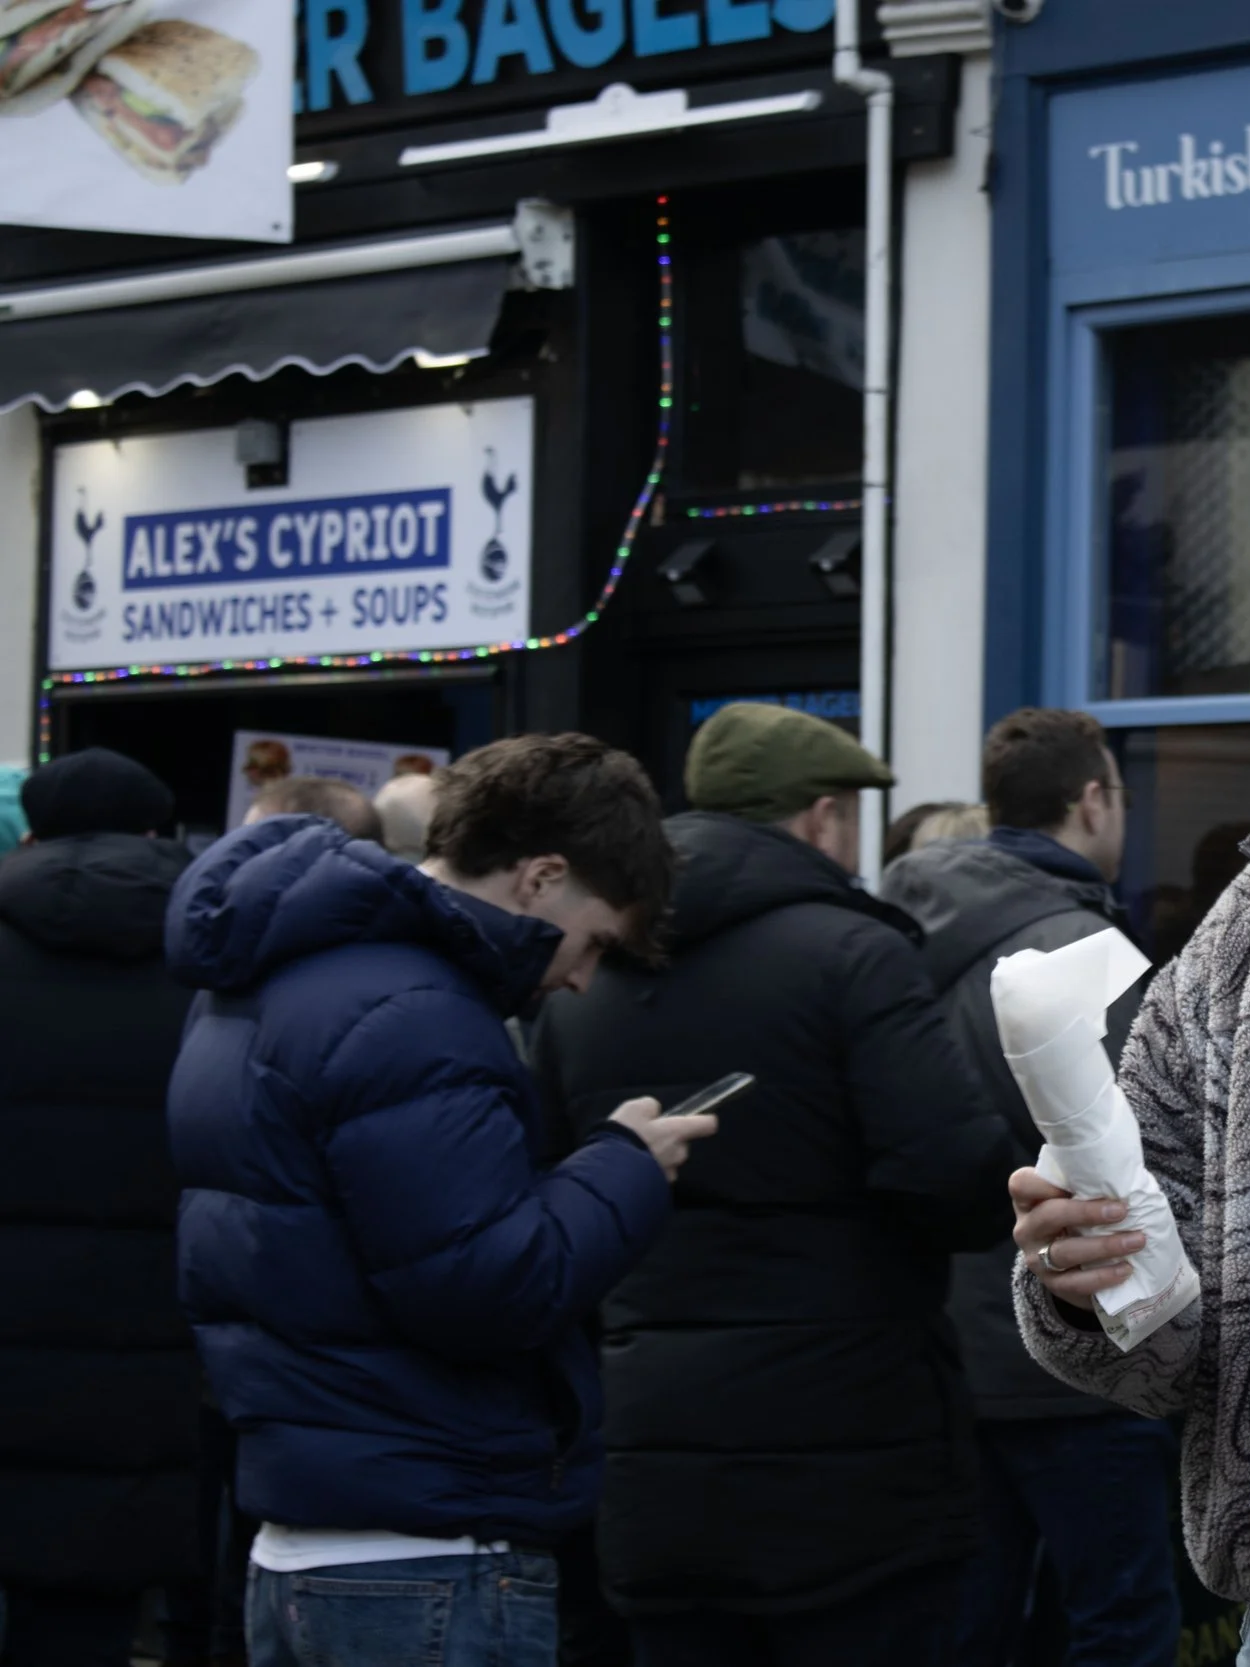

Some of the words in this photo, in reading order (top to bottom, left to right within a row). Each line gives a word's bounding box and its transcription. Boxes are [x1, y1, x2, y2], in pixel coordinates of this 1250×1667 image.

[293, 0, 374, 113] R
[403, 0, 837, 97] BAG
[126, 515, 259, 580] ALEX'S
[267, 500, 447, 569] CYPRIOT
[122, 593, 313, 643] SANDWICHES
[351, 582, 448, 629] SOUPS
